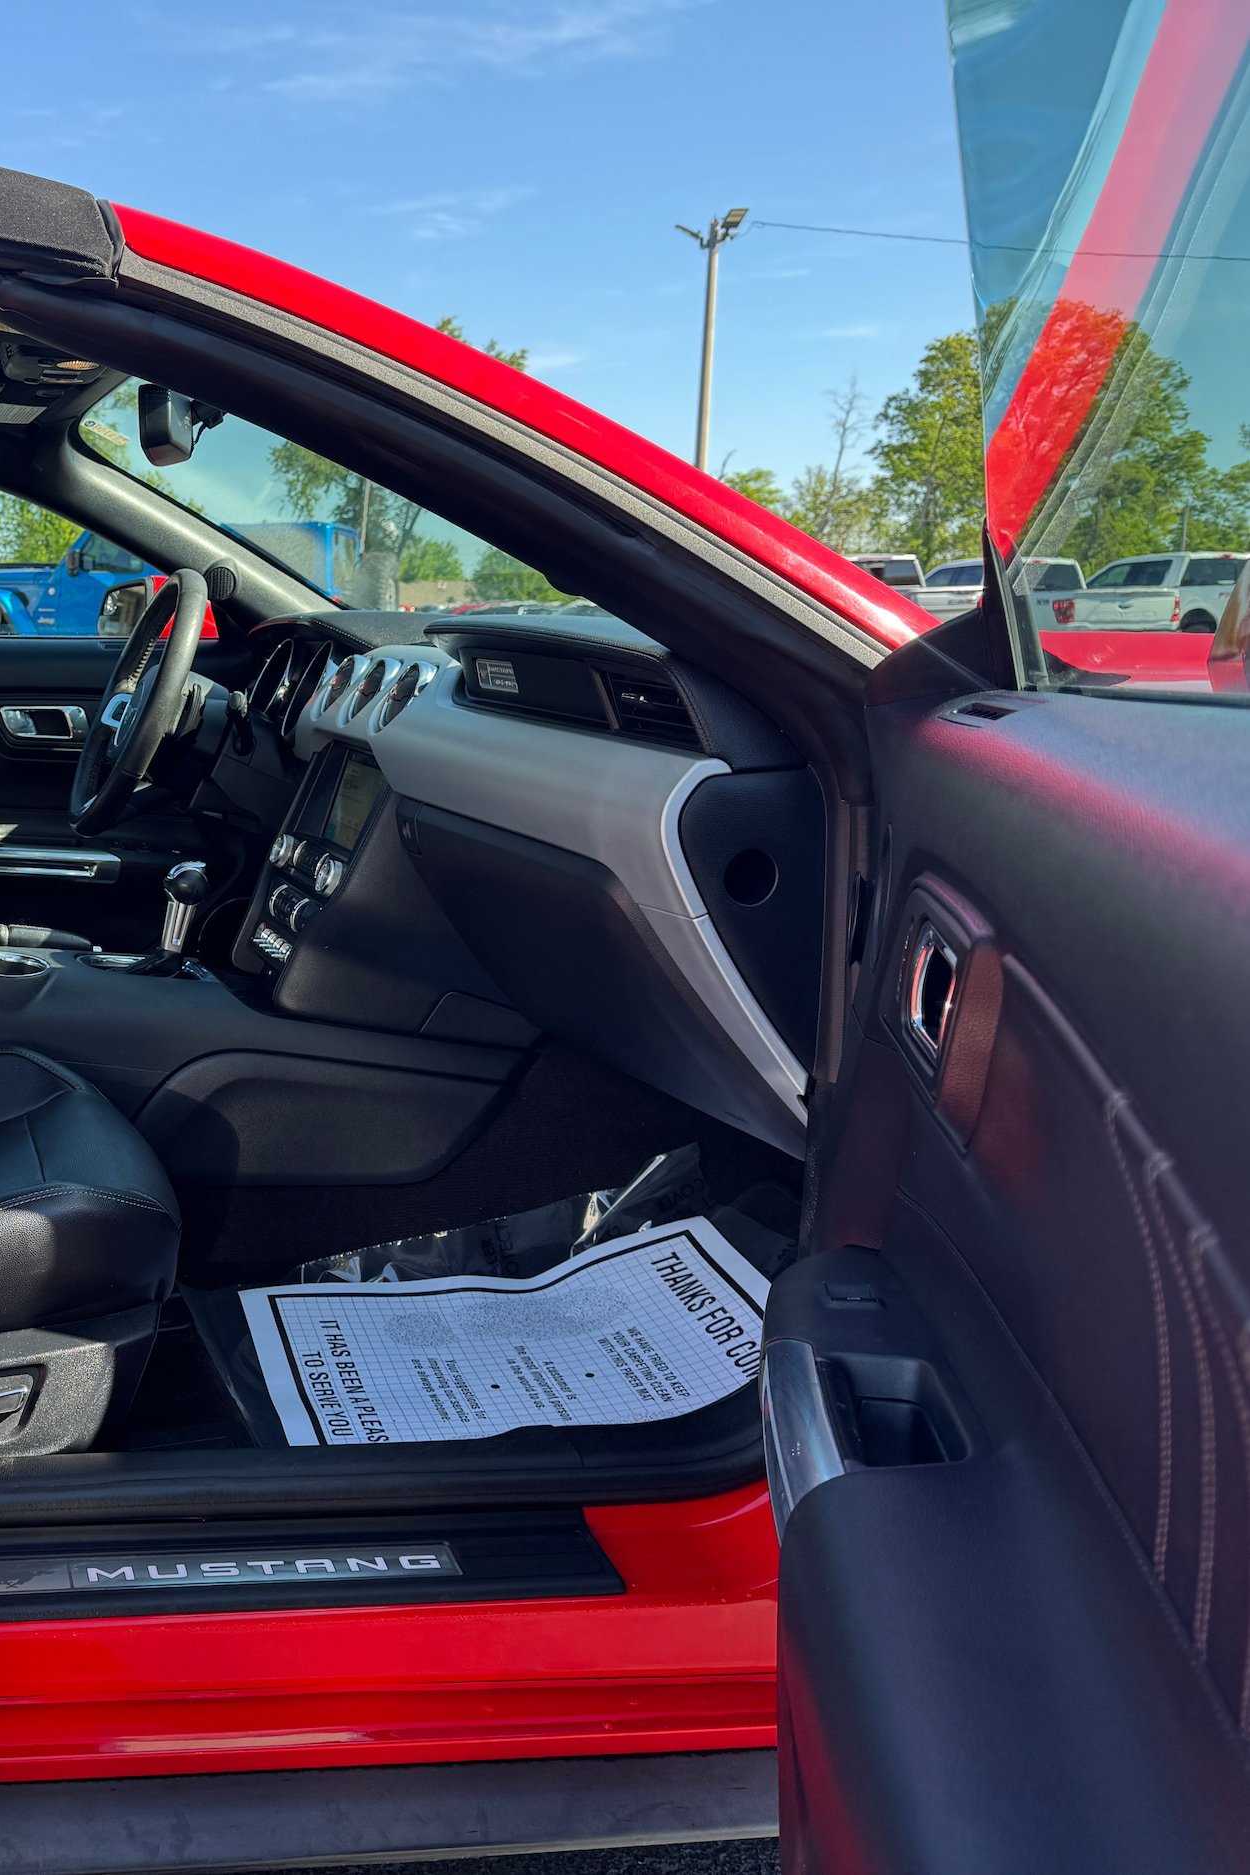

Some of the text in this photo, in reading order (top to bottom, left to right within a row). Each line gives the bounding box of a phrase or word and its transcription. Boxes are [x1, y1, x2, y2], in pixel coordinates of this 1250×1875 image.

[319, 1320, 340, 1330] IT
[651, 1252, 717, 1312] THANKS
[697, 1307, 744, 1346] FOR
[324, 1333, 351, 1358] HAS
[411, 1358, 423, 1370] are
[417, 1368, 435, 1394] always
[598, 1338, 654, 1401] WITH THIS PAPER MAT
[612, 1331, 673, 1402] YOUR CARPETING CLEAN
[627, 1326, 690, 1398] WE HAVE TRIED TO KEEP
[302, 1351, 353, 1437] TO SERVE YOU
[335, 1361, 365, 1395] BEEN
[428, 1357, 470, 1424] improving our service
[445, 1359, 487, 1420] Your suggestions for
[510, 1363, 522, 1374] the
[517, 1376, 536, 1393] world
[514, 1345, 572, 1421] the most important person
[547, 1366, 572, 1393] customer
[86, 1554, 442, 1582] MUSTANG
